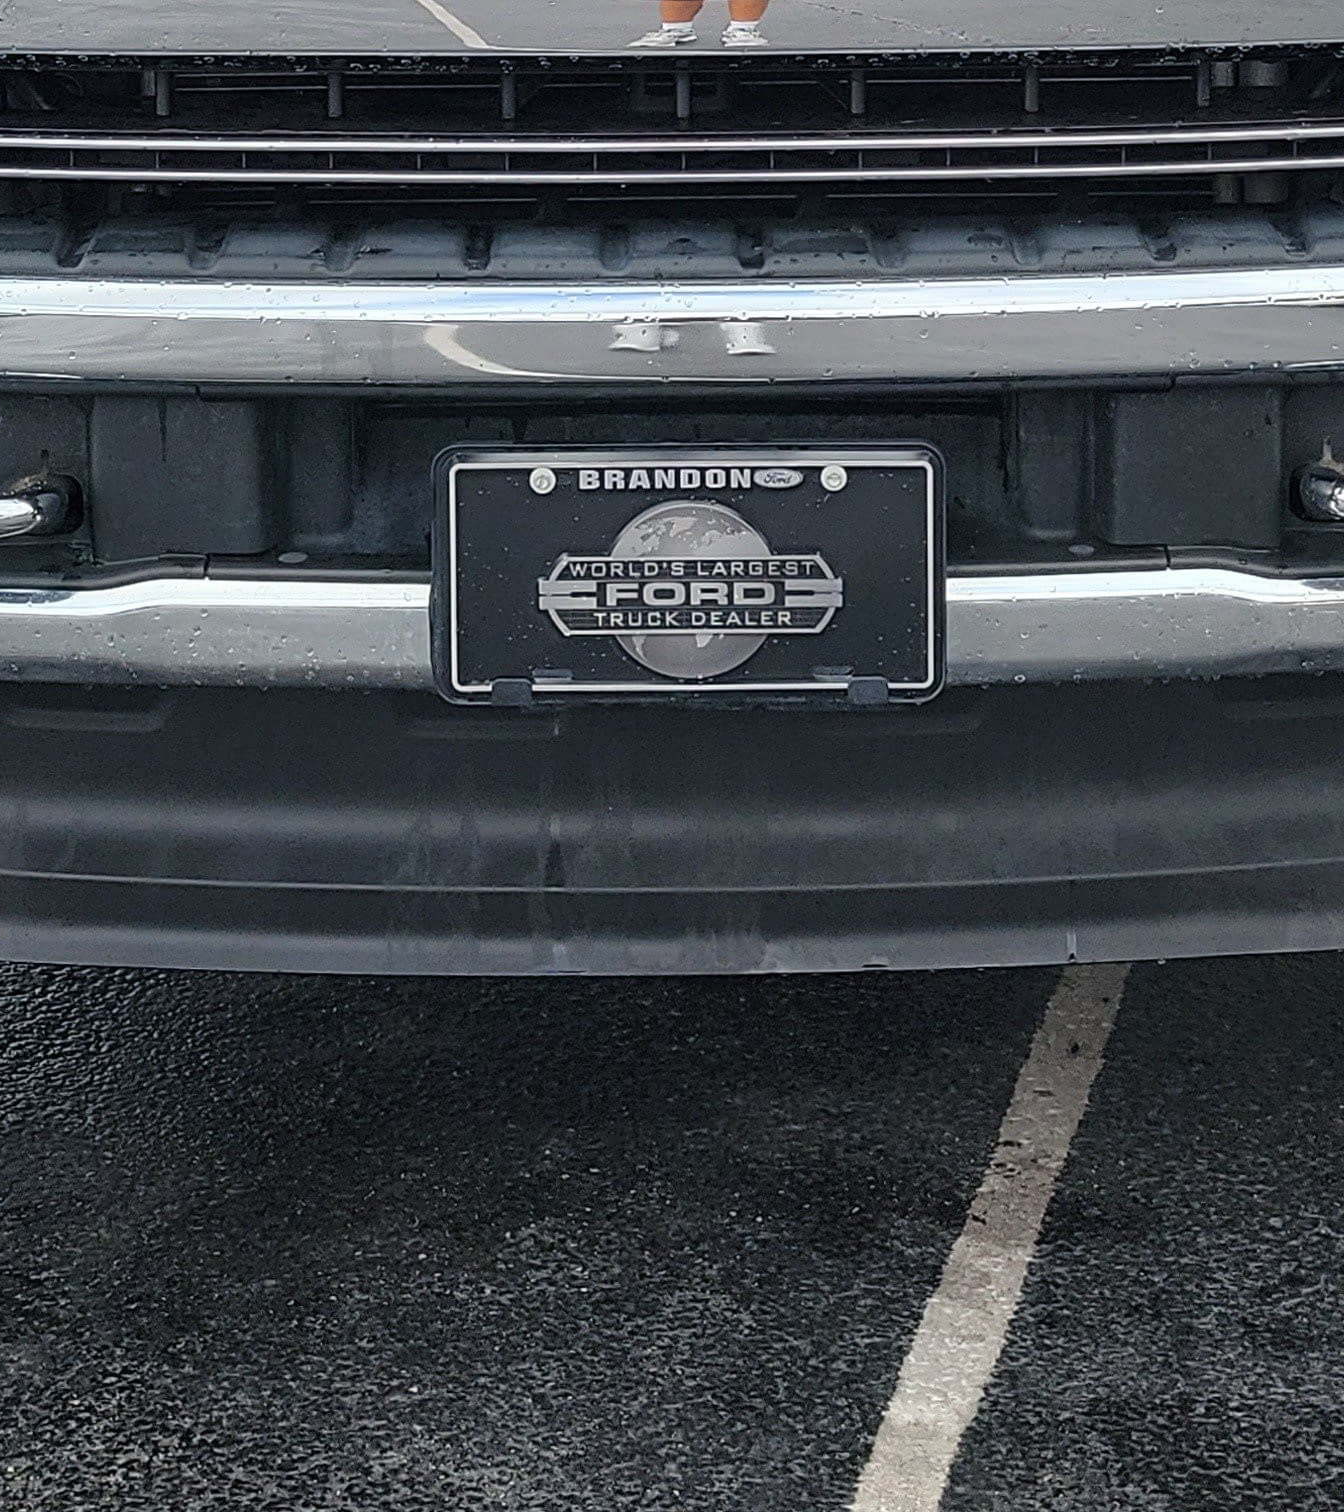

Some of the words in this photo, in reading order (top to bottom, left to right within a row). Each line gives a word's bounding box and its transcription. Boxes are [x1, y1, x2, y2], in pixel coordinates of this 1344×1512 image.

[578, 468, 752, 490] BRANDON
[569, 561, 684, 577] WORLD'S
[697, 561, 816, 576] LARGEST
[606, 582, 776, 606] FORD
[593, 611, 680, 627] TRUCK
[691, 611, 792, 626] DEALER
